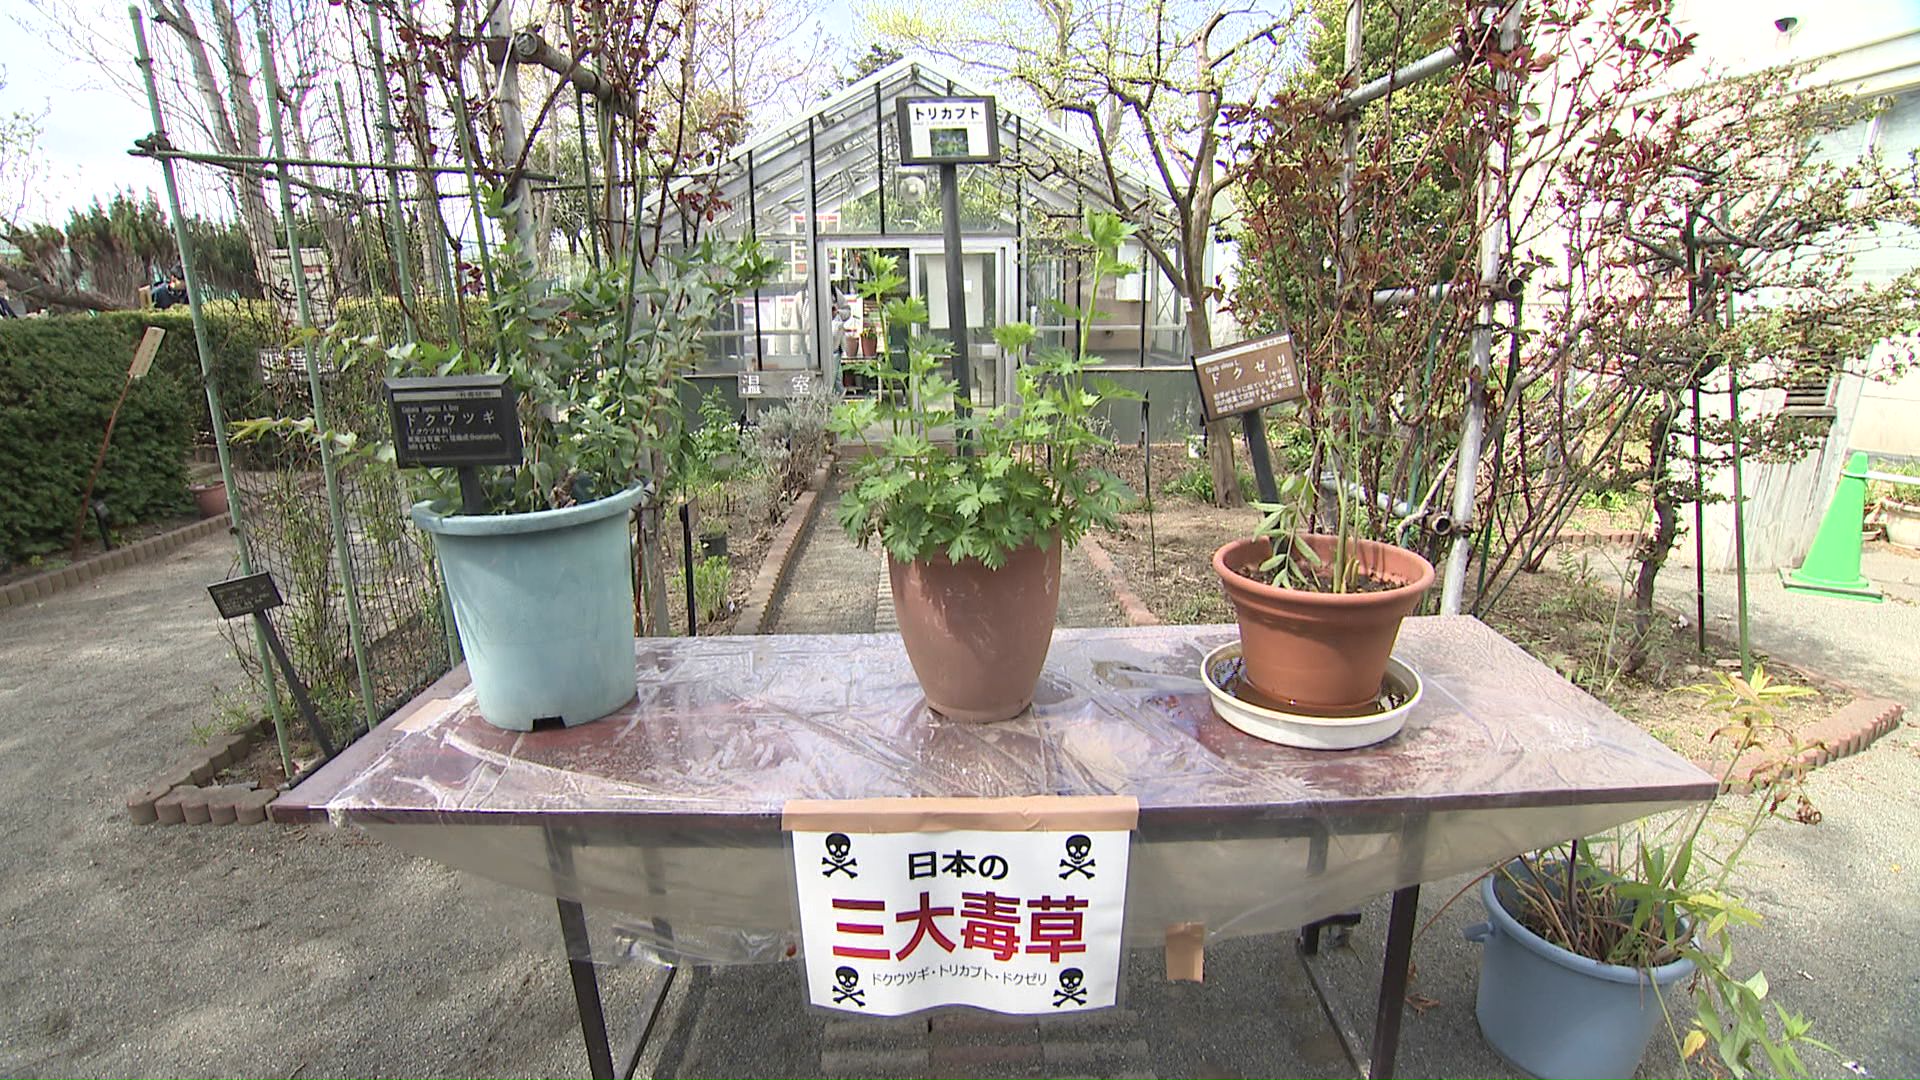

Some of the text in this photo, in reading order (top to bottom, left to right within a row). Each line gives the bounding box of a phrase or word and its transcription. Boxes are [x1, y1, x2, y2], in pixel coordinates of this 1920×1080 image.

[915, 106, 980, 121] トリカブト
[1212, 353, 1286, 386] ドクゼリ
[741, 374, 811, 395] 温室
[407, 410, 495, 427] ドクウツギ
[908, 850, 1008, 880] 日本の
[832, 891, 1089, 963] 三大毒草
[872, 964, 1048, 987] ドクウツギ・トリカブト・ドクゼリ
